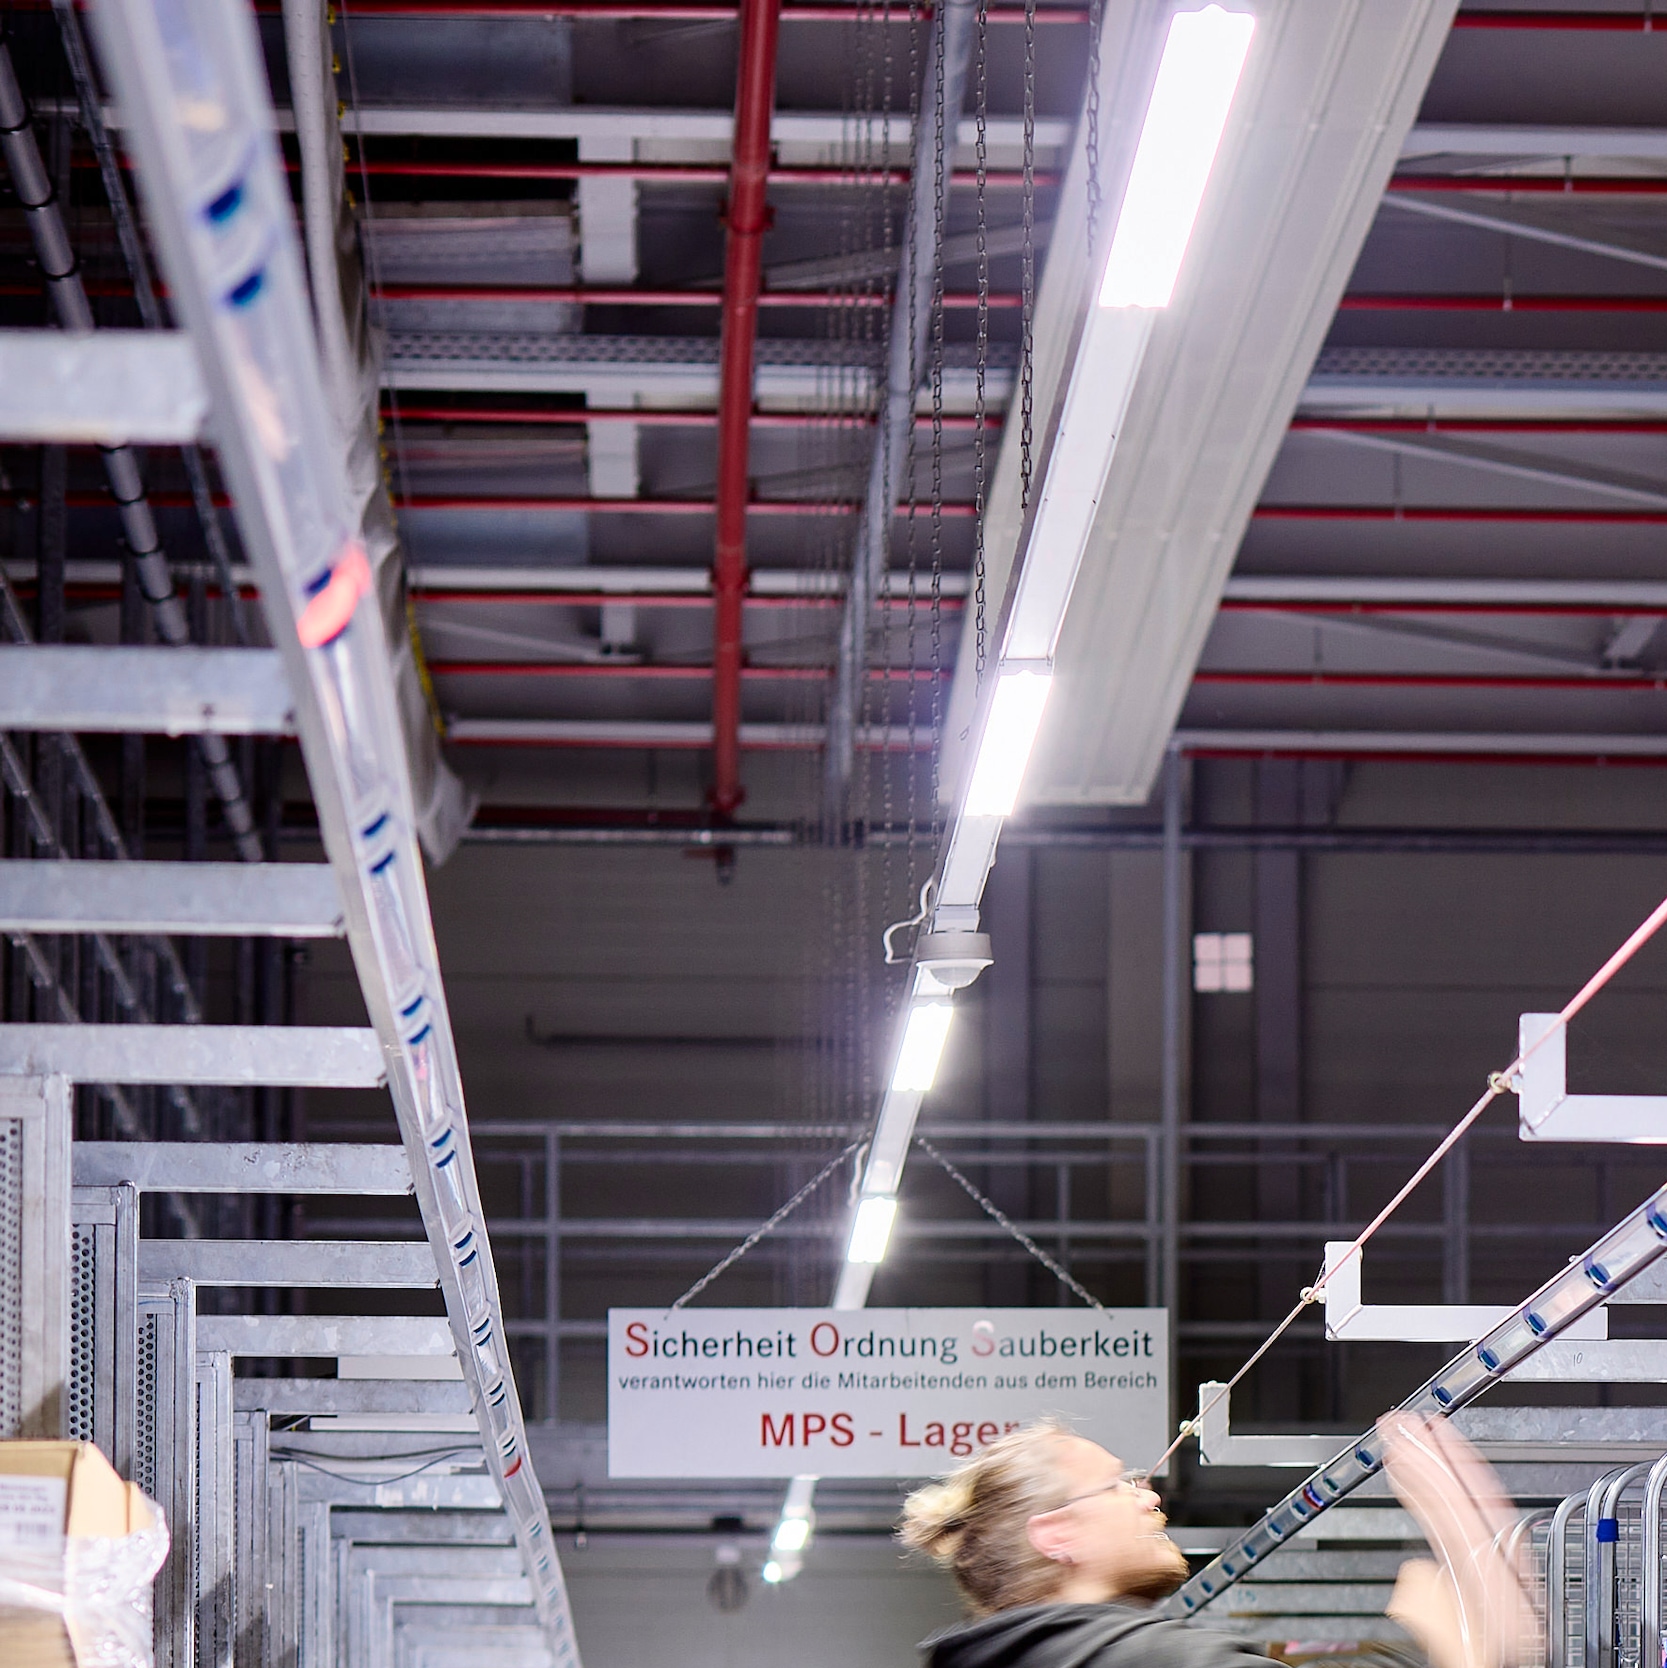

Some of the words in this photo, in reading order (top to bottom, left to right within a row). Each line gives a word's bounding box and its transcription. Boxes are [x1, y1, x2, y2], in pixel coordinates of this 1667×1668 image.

[625, 1322, 798, 1358] Sicherheit
[810, 1321, 958, 1365] Ordnung
[971, 1319, 1154, 1358] Sauberkeit
[1573, 1352, 1584, 1368] 10
[618, 1373, 751, 1390] verantworten
[757, 1371, 797, 1390] hier
[801, 1371, 832, 1390] die
[838, 1371, 988, 1390] Mitarbeitenden
[994, 1375, 1029, 1390] aus
[1034, 1371, 1078, 1390] dem
[1084, 1371, 1159, 1390] Bereich
[761, 1412, 855, 1448] MPS
